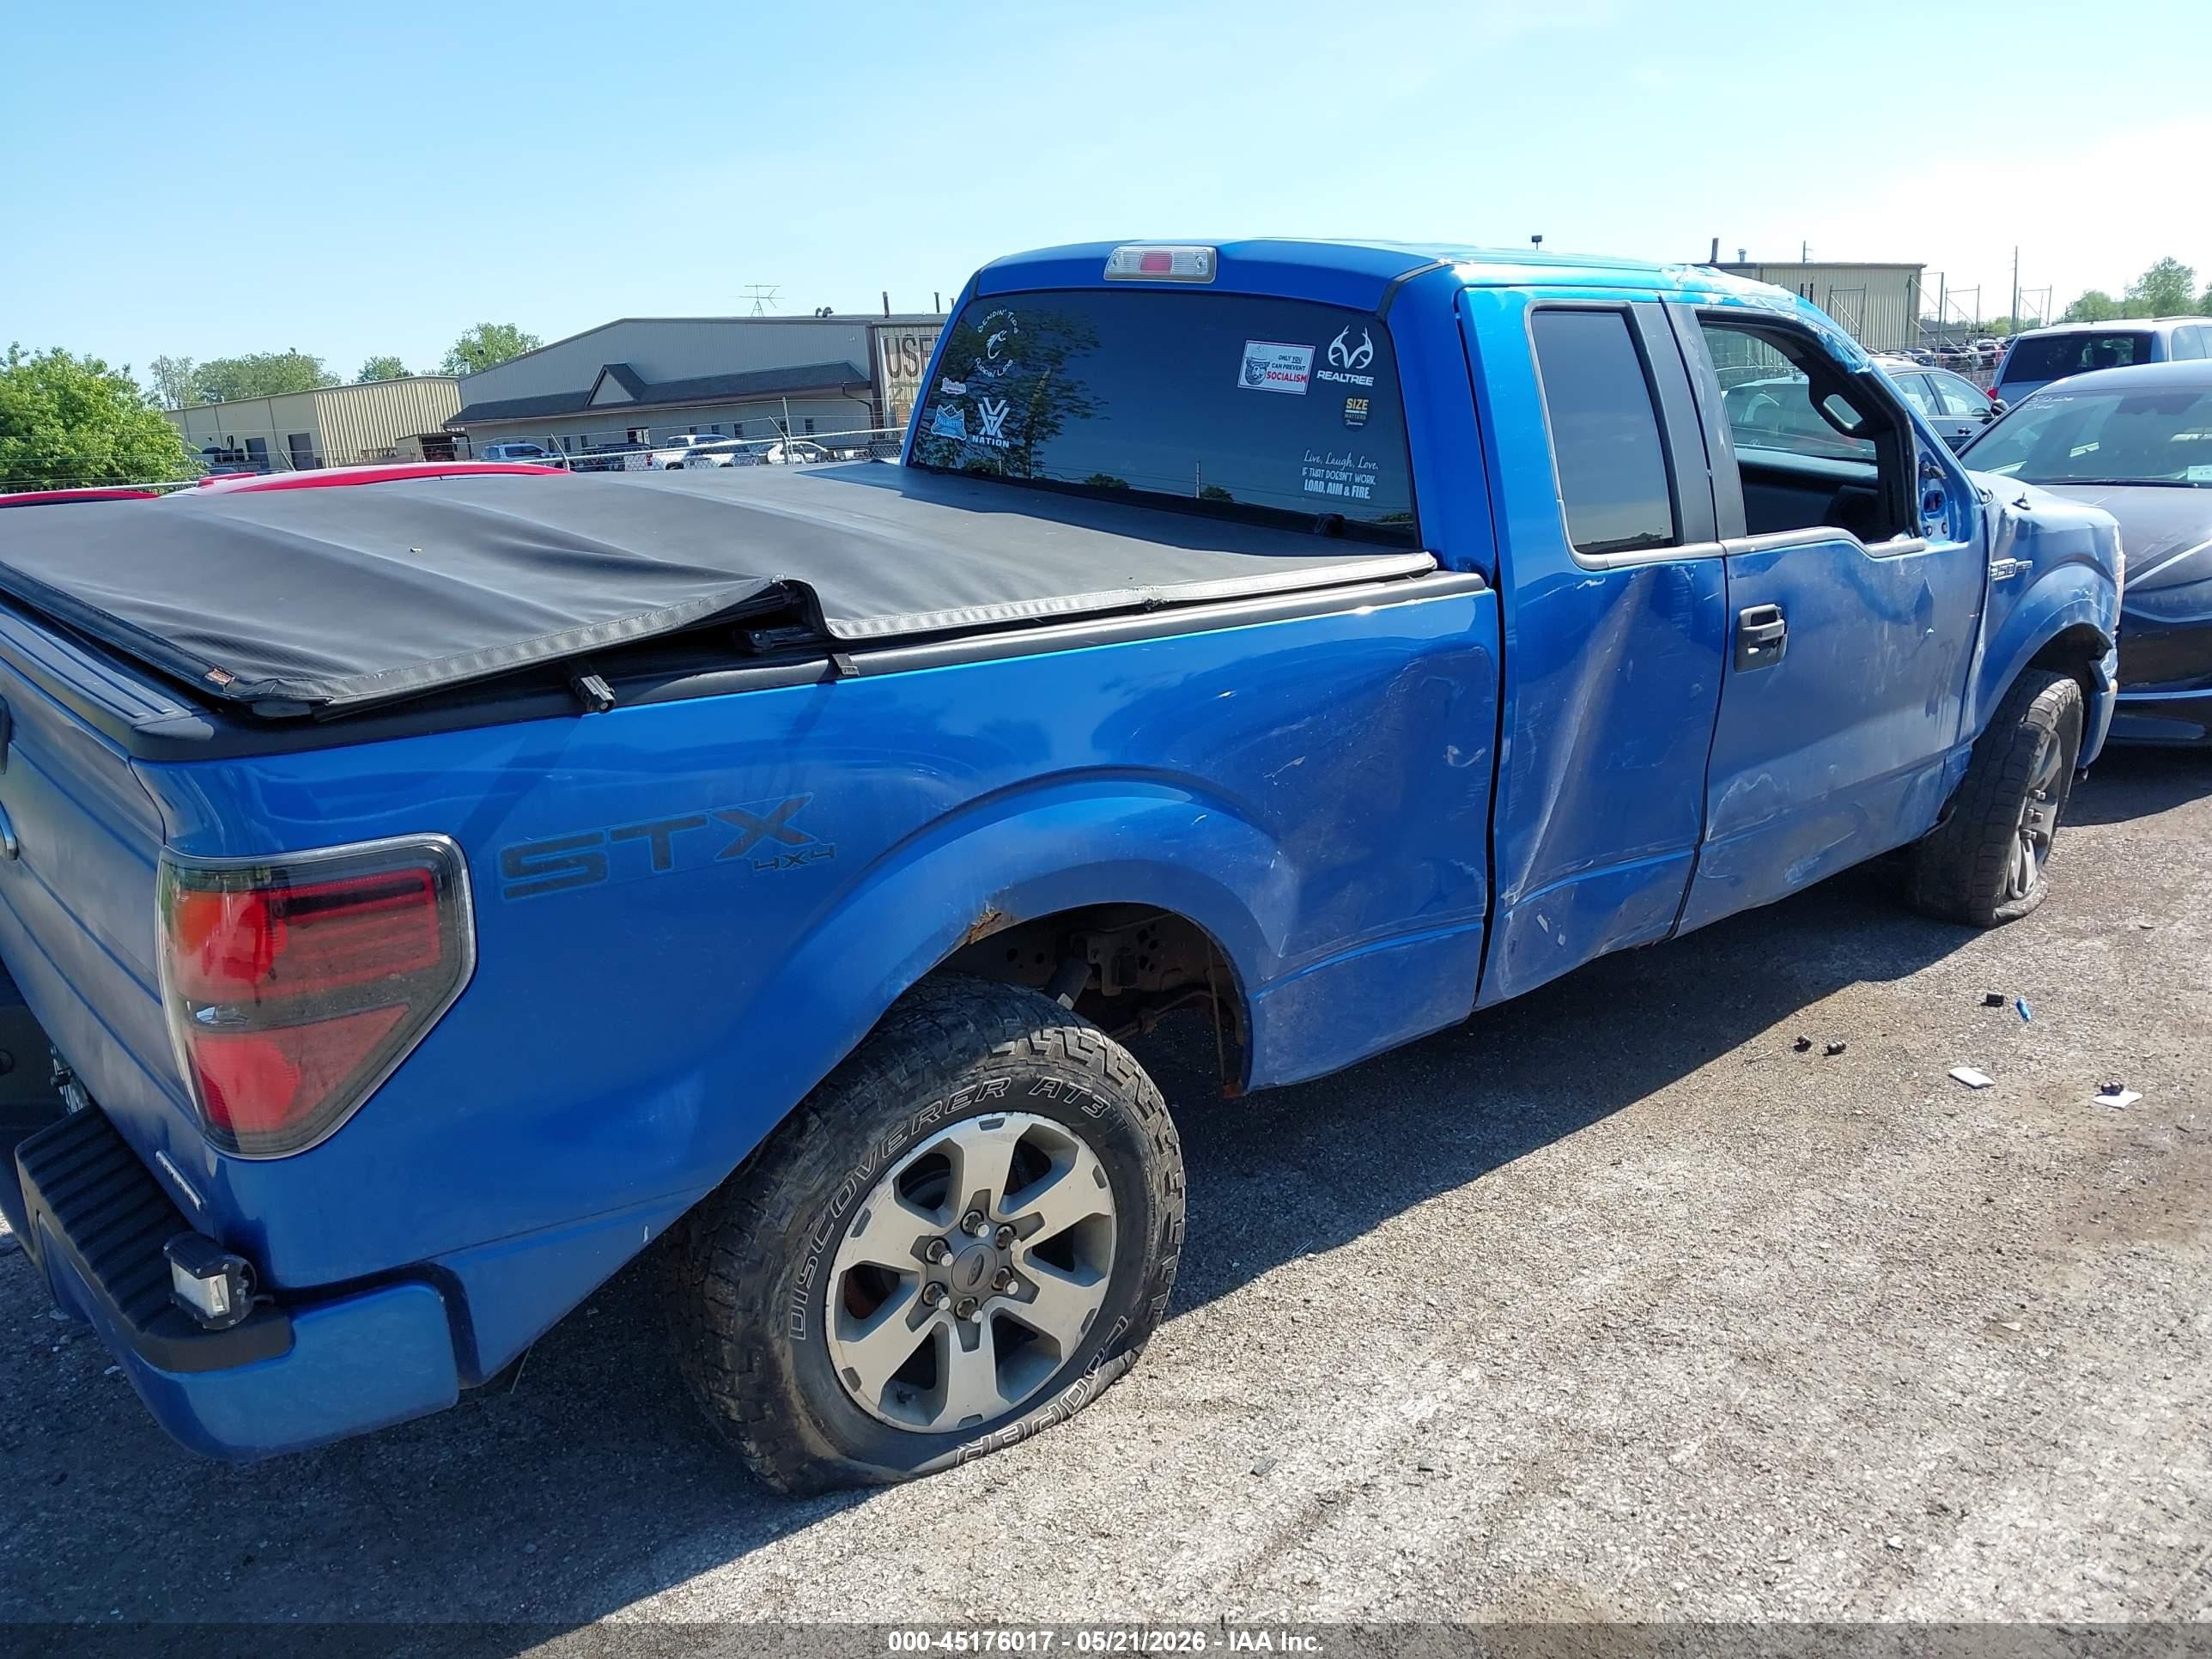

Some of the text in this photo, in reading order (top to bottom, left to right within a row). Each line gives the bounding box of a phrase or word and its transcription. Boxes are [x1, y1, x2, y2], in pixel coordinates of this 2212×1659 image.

[1267, 371, 1307, 383] SOCIALISM
[1317, 370, 1374, 386] REALTREE
[1346, 398, 1369, 410] SIZE
[972, 434, 1010, 448] NATION
[1309, 468, 1324, 478] THAT
[1327, 482, 1343, 495] AIM
[1343, 487, 1350, 496] &
[500, 792, 815, 900] STX
[789, 1077, 1110, 1340] DISCOVERER AT3
